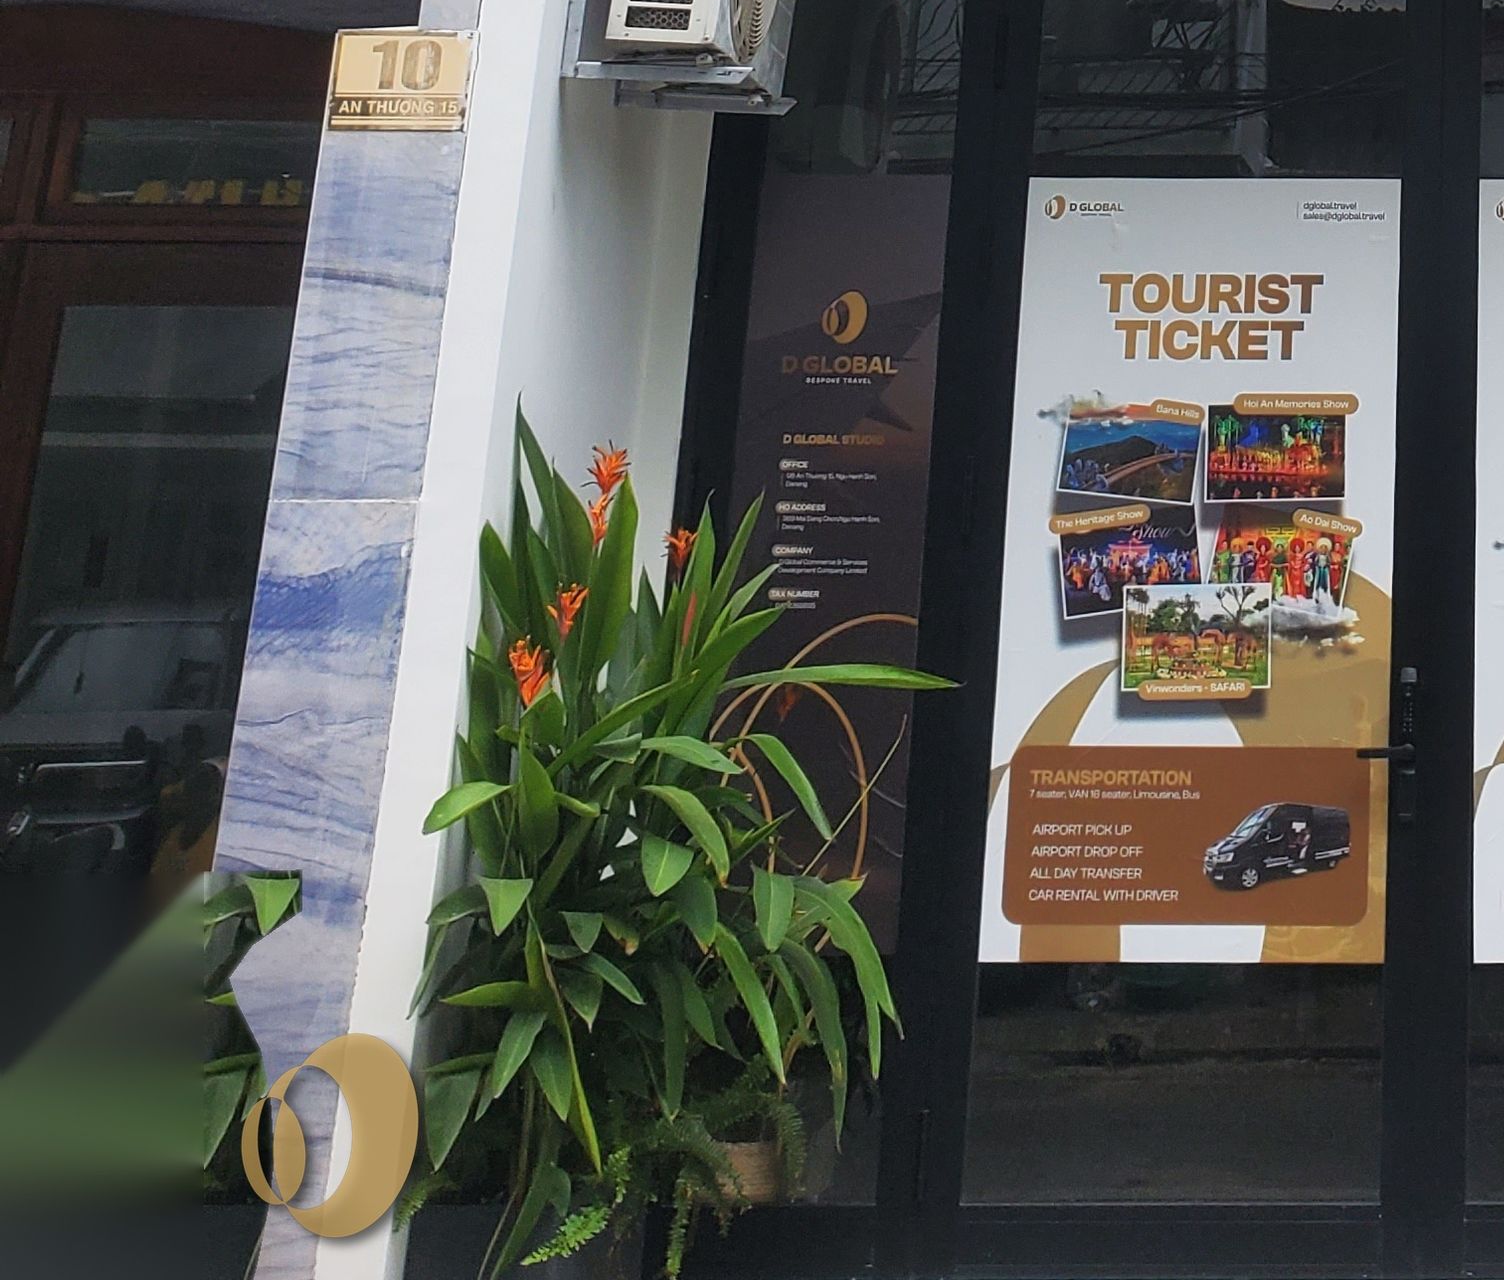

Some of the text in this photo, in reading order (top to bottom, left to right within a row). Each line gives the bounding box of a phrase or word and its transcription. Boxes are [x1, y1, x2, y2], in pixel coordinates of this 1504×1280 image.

[373, 40, 442, 90] 10
[339, 100, 361, 114] AN
[441, 101, 457, 114] 15
[1069, 202, 1124, 212] D GLOBAL
[1099, 273, 1324, 314] TOURIST
[1114, 319, 1305, 360] TICKET
[783, 356, 899, 374] D GLOBAL
[1243, 399, 1349, 409] Hoi An Memories Show
[783, 434, 792, 444] D
[793, 434, 840, 445] GLOBAL
[1056, 509, 1143, 529] The Heritage Show
[1300, 514, 1357, 533] Ao Dai Show
[1210, 682, 1246, 692] SAFARI
[1030, 770, 1192, 786] TRANSPORTATION
[1068, 788, 1089, 798] VAN
[1182, 789, 1200, 799] Bus
[1032, 823, 1133, 836] AIRPORT PICK UP
[1031, 845, 1144, 858] AIRPORT DROP OFF
[1029, 867, 1143, 879] ALL DAY TRANSFER
[1028, 889, 1179, 901] CAR RENTAL WITH DRIVER
